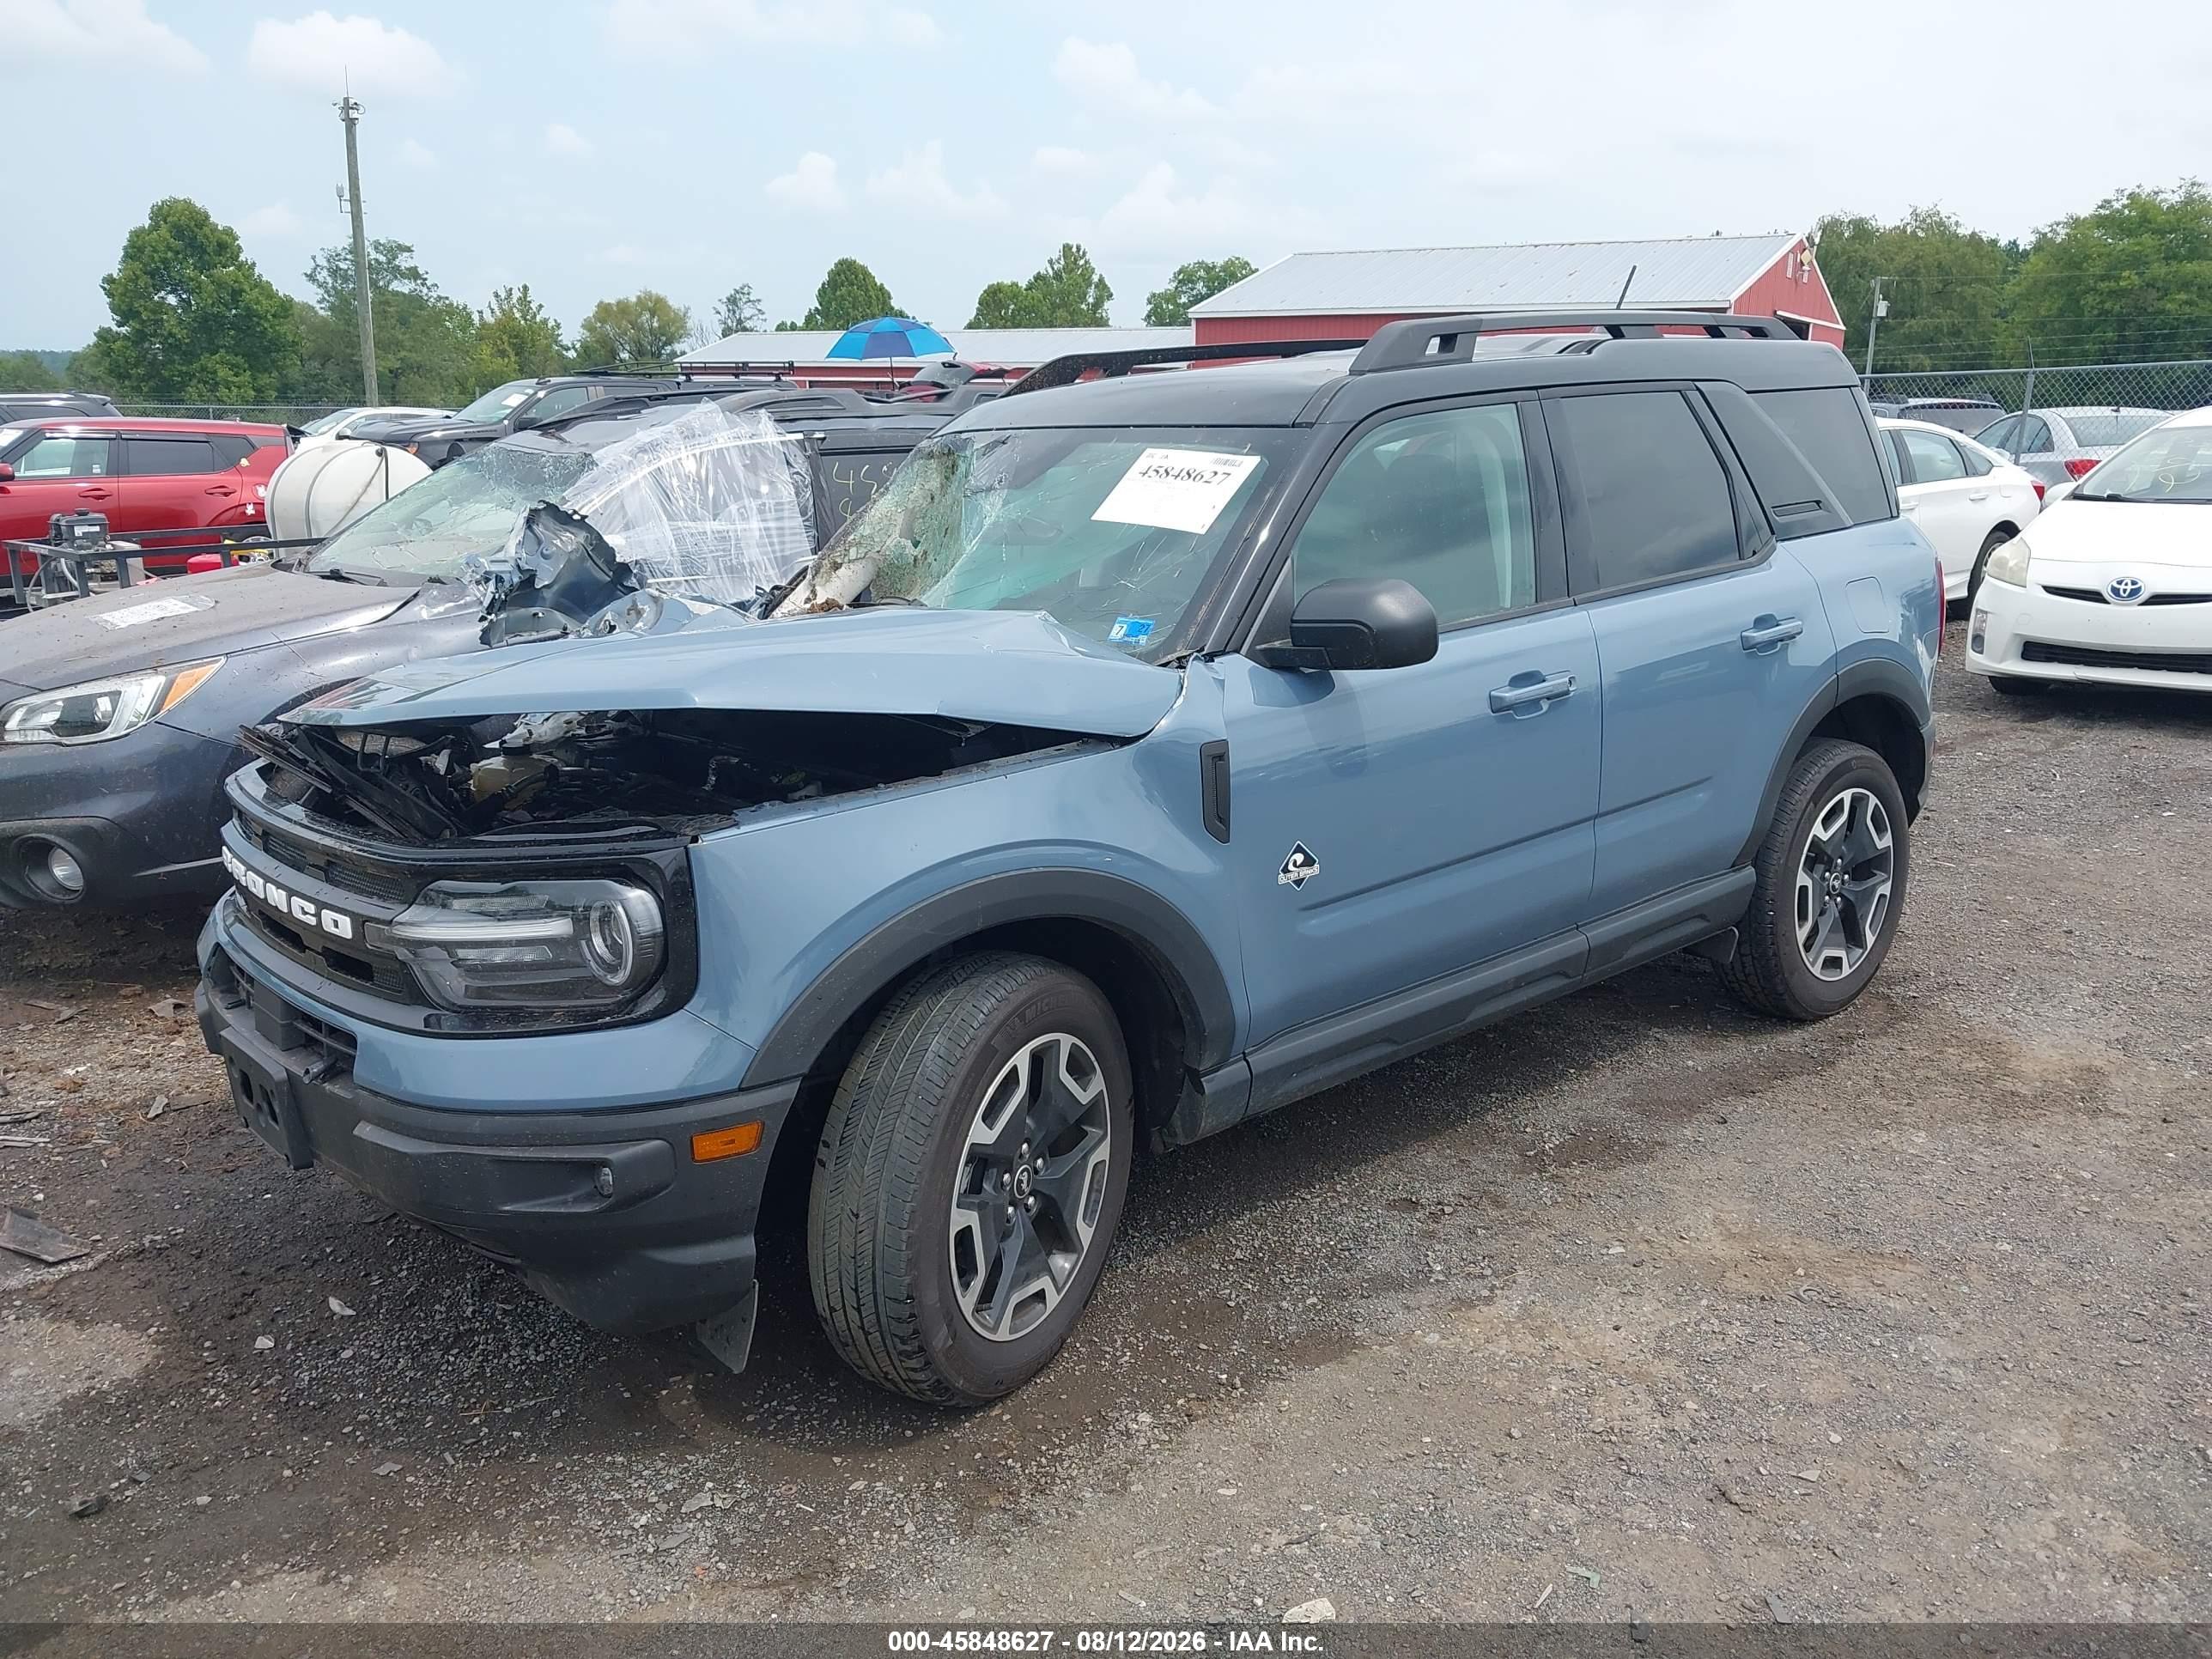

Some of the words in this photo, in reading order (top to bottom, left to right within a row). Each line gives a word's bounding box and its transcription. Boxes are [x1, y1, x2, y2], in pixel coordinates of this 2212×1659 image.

[1139, 464, 1232, 486] 45848627
[1115, 625, 1125, 635] 7
[1137, 623, 1153, 634] 27
[1280, 872, 1299, 883] OUTER
[1300, 866, 1318, 878] BANKS
[221, 845, 353, 940] BRONCO
